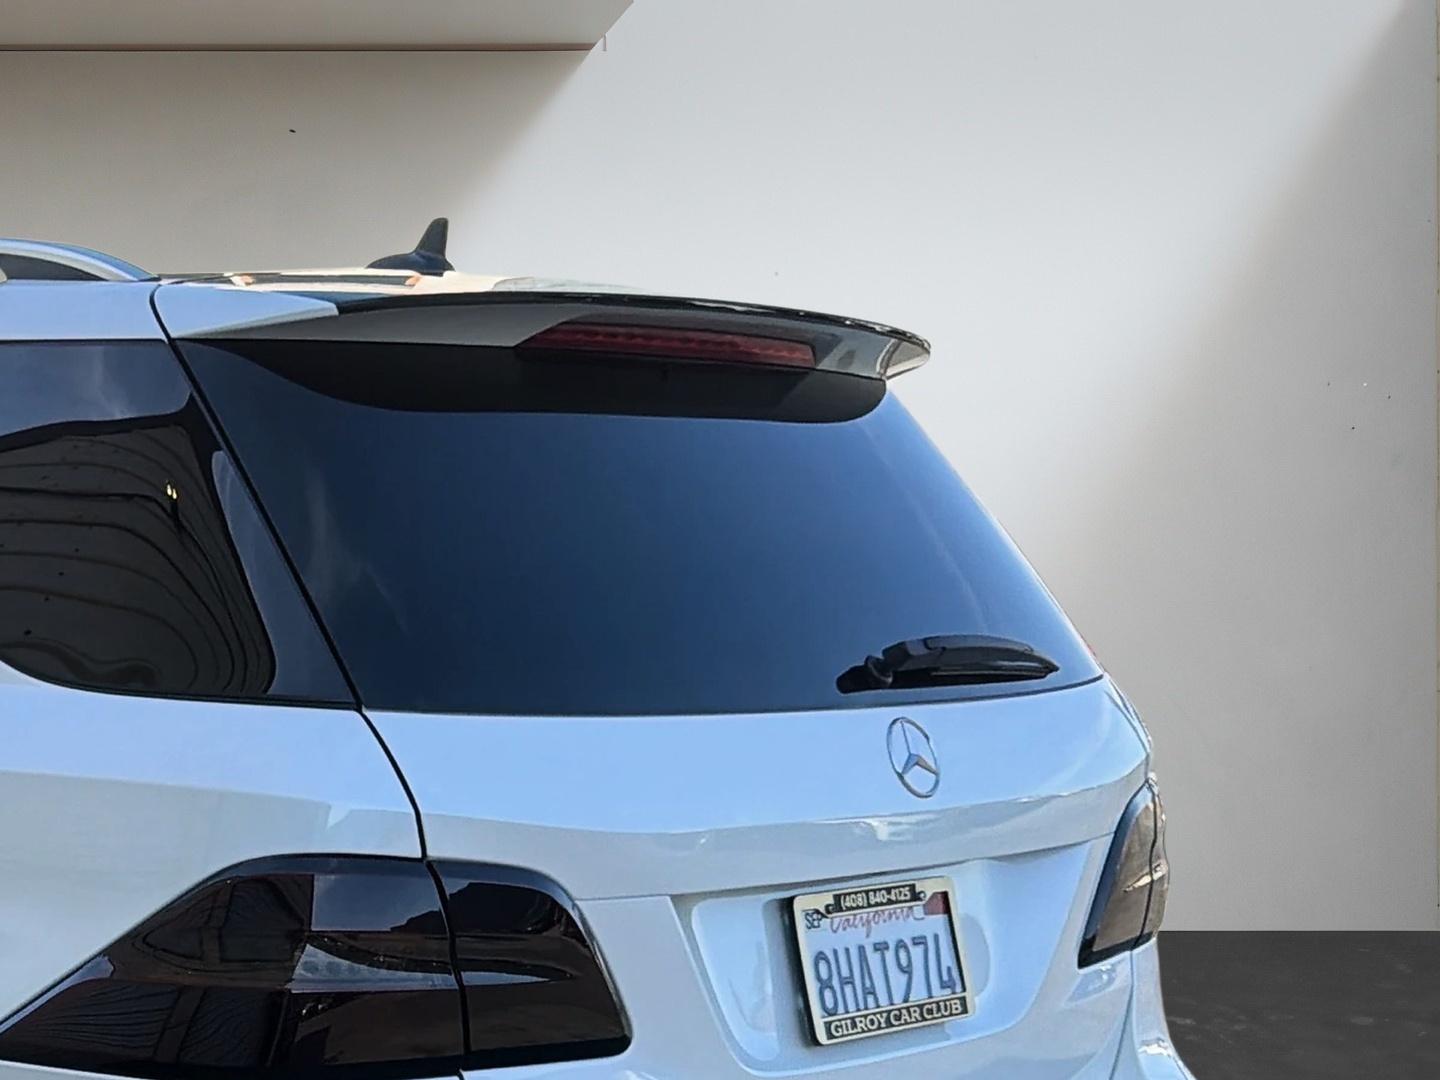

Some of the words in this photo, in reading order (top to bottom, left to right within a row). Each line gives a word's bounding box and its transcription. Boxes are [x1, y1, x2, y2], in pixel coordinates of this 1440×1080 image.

[813, 933, 957, 1017] 8HAT974
[830, 1012, 889, 1036] GILROY
[890, 1005, 922, 1026] CAR
[922, 999, 962, 1019] CLUB
